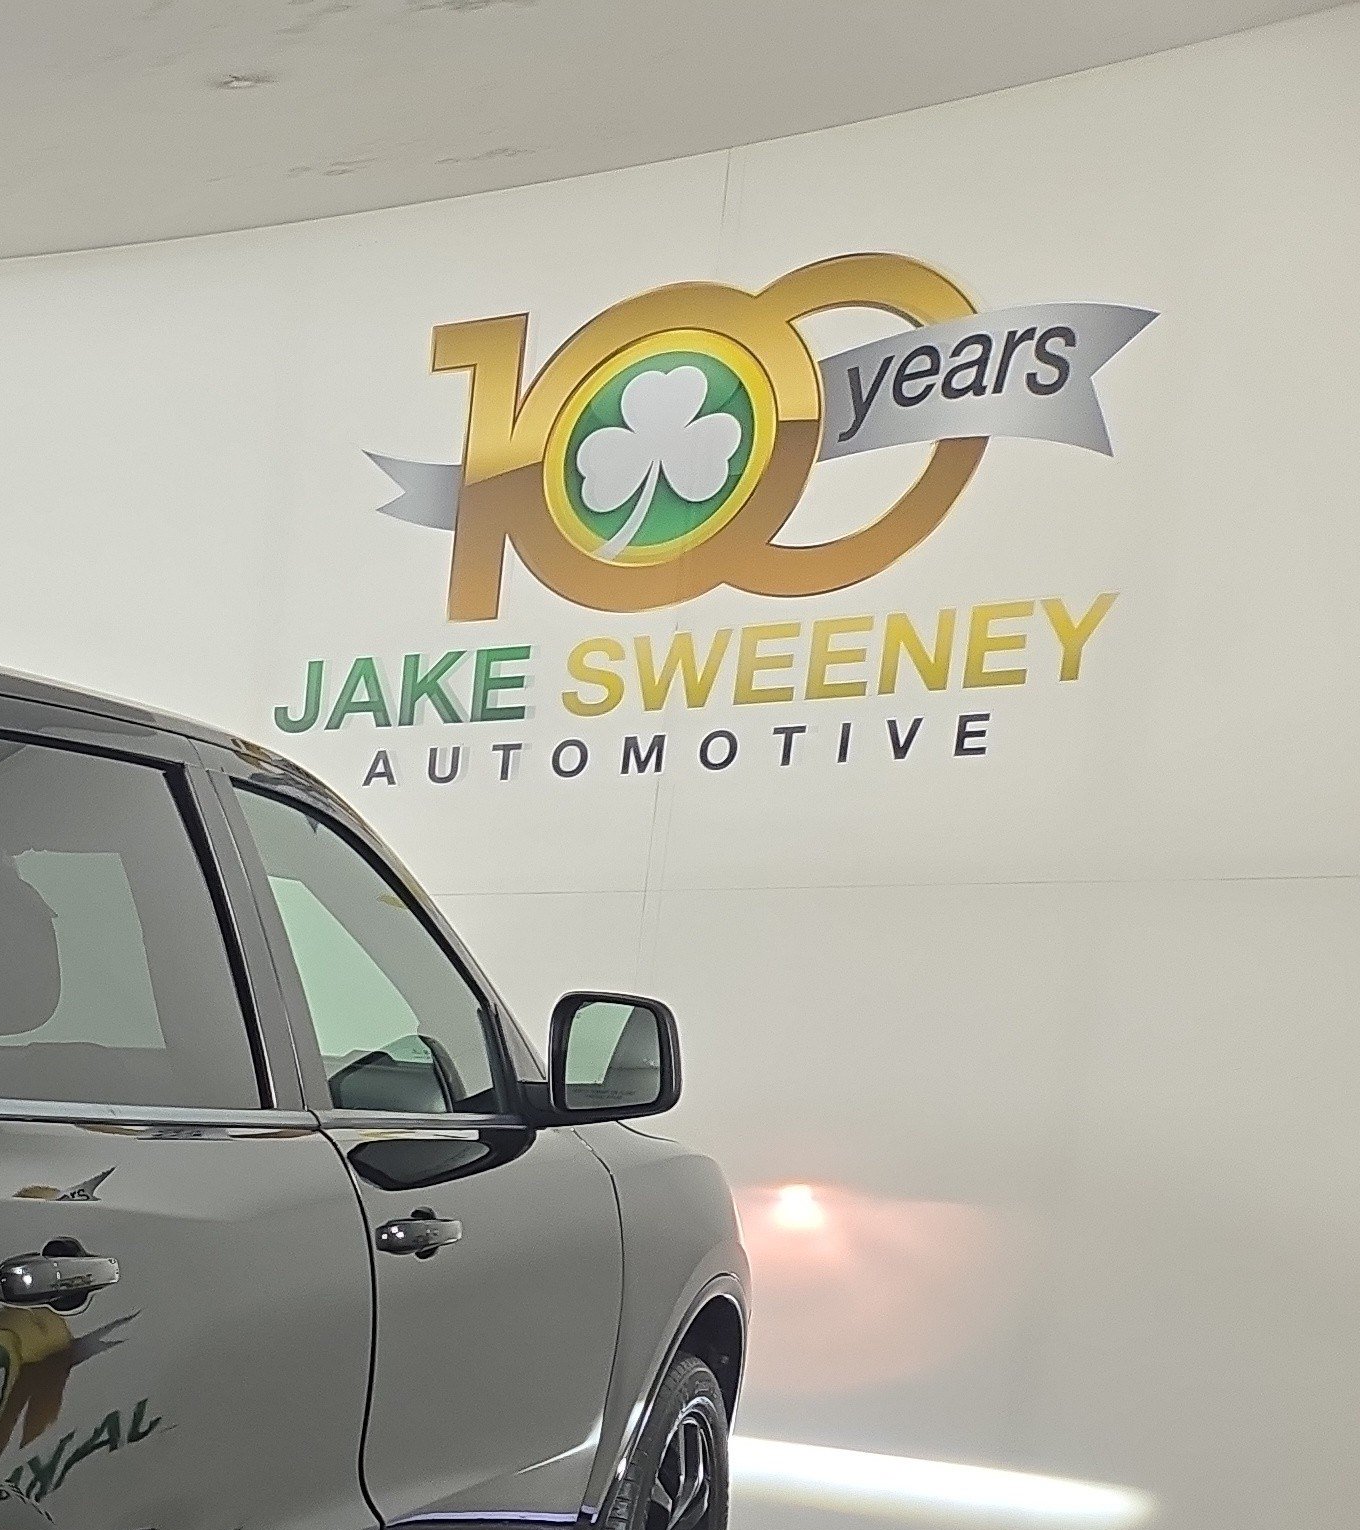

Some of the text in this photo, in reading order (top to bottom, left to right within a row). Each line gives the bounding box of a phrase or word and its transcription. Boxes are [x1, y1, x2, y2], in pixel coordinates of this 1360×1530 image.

[838, 325, 1078, 443] years
[272, 592, 1120, 735] JAKE SWEENEY
[363, 712, 991, 788] AUTOMOTIVE
